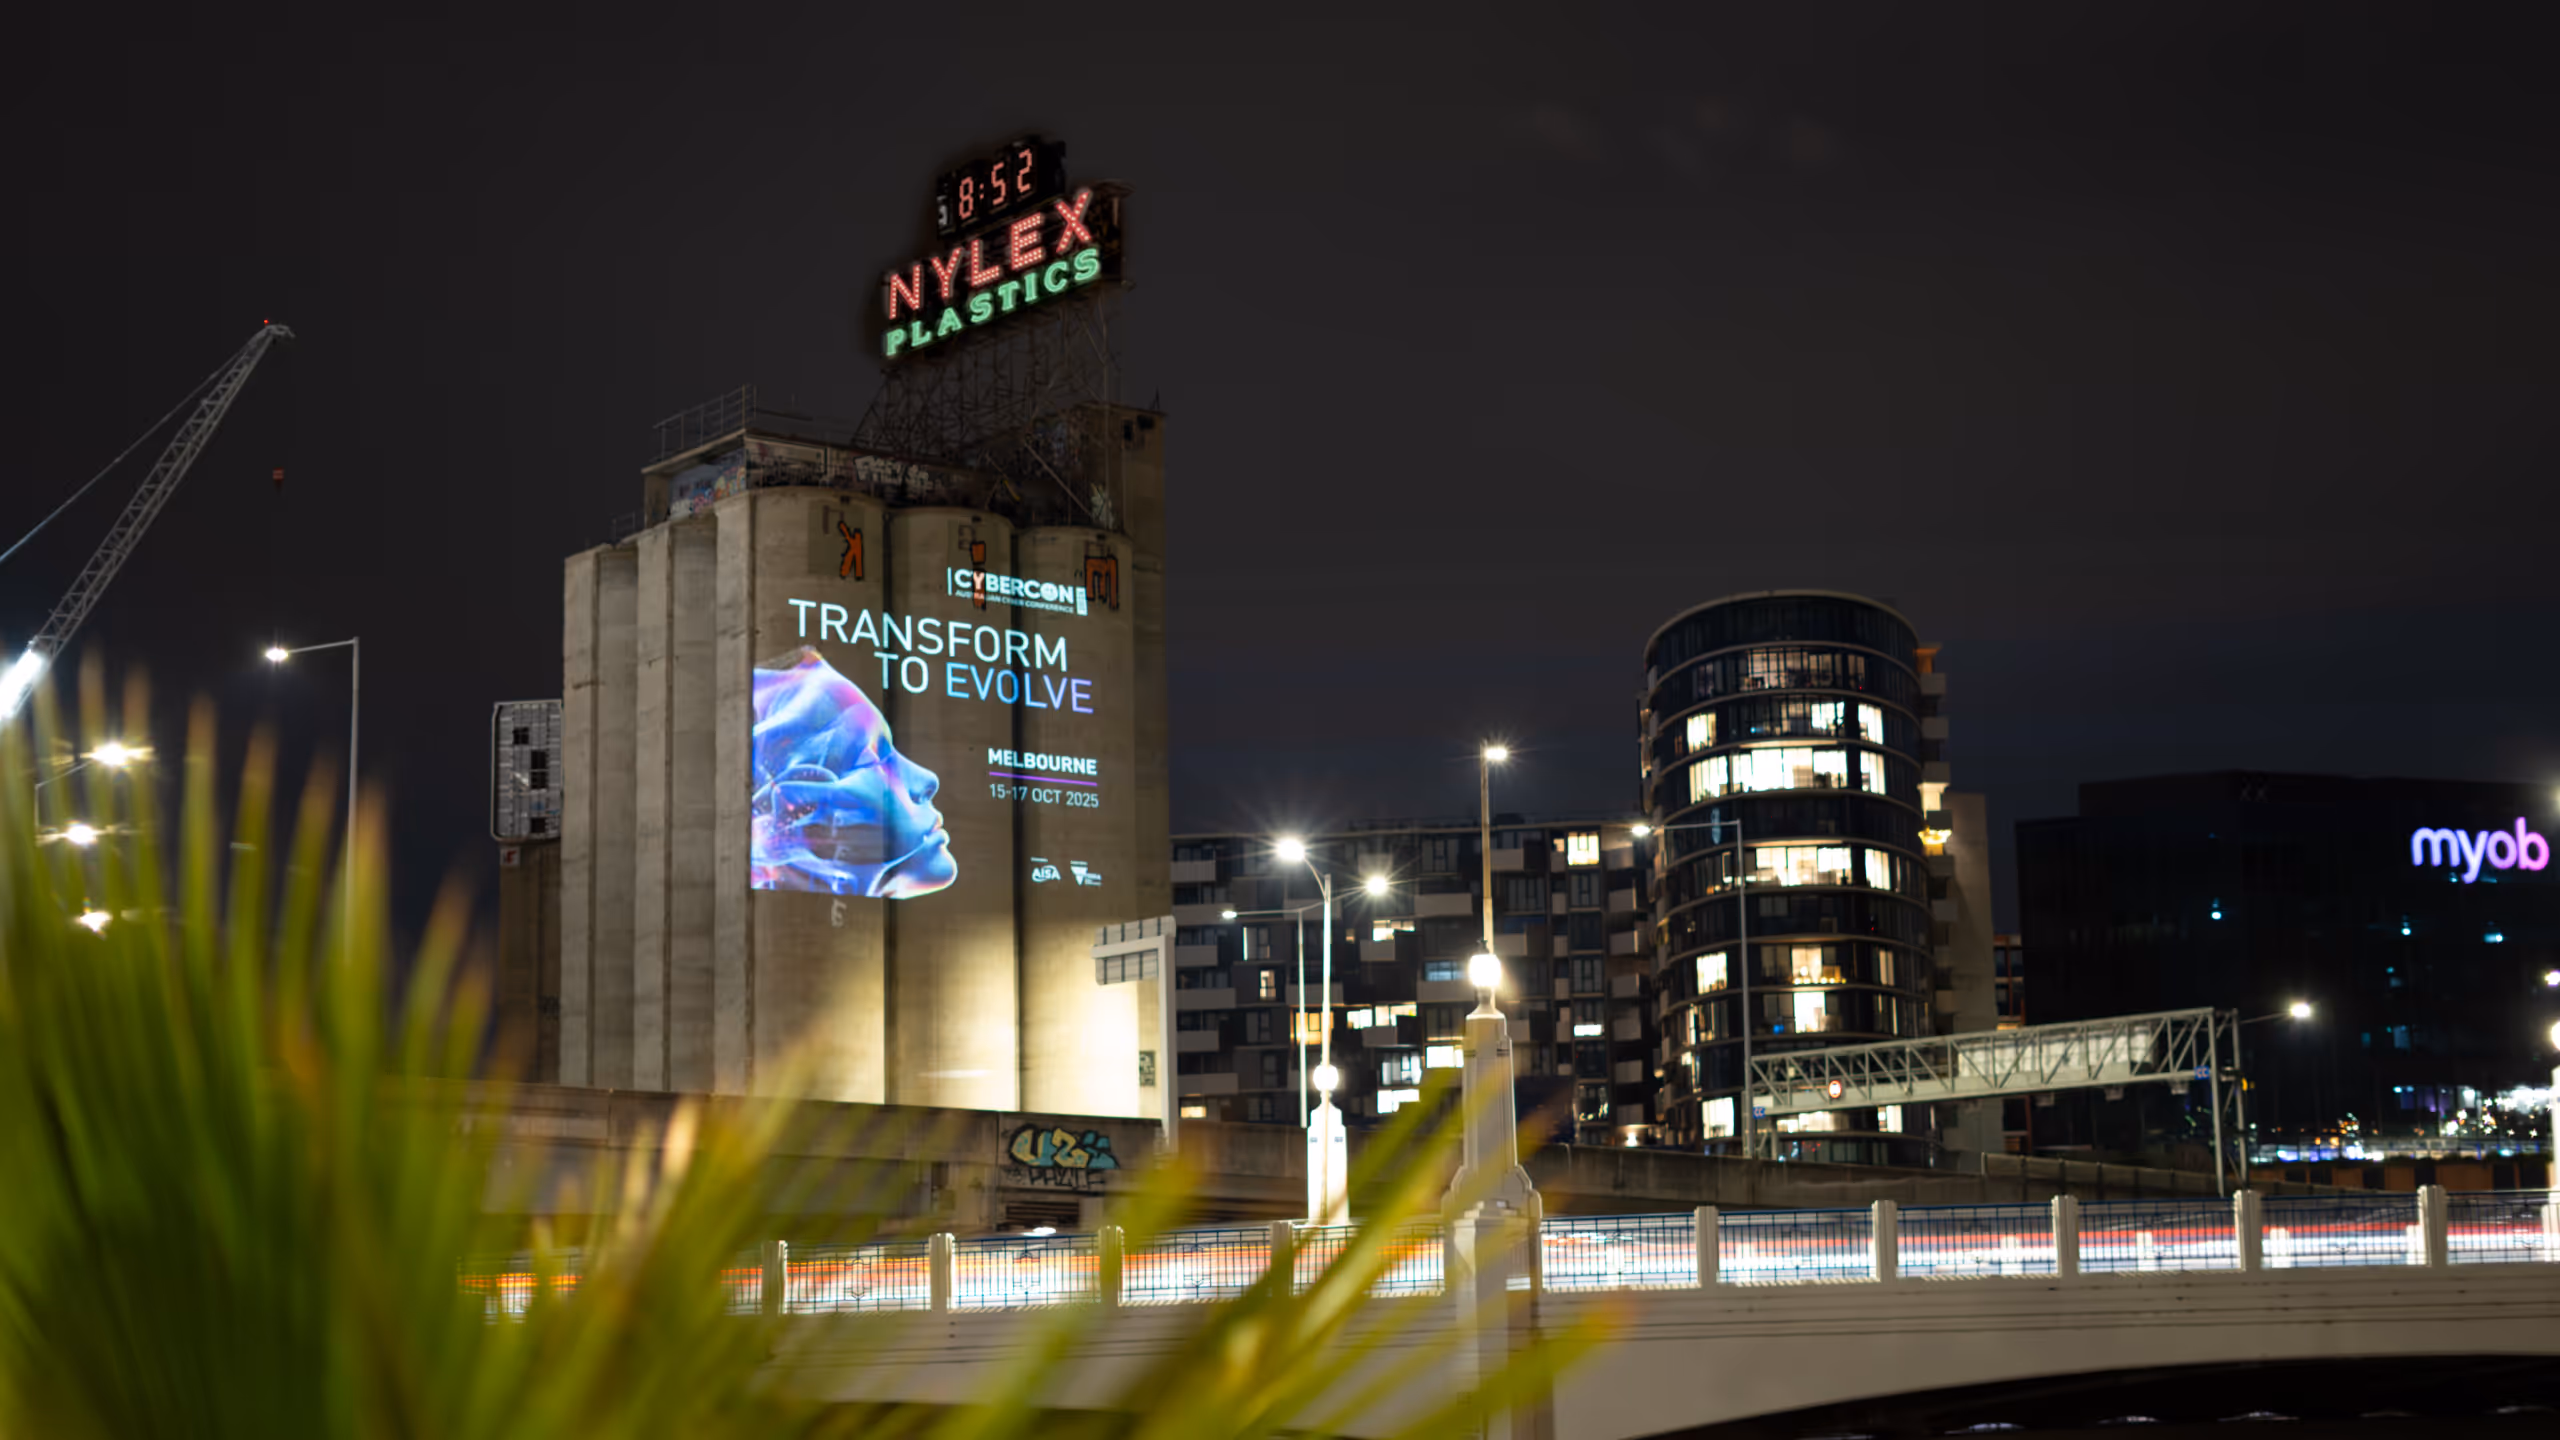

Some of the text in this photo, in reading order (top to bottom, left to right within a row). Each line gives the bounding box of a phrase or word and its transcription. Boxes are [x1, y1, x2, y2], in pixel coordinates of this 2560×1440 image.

[958, 149, 1033, 219] 8:52
[888, 188, 1094, 320] NYLEX
[885, 247, 1101, 357] PLASTICS
[954, 567, 1075, 605] CYBERCON
[788, 597, 1068, 672] TRANSFORM
[873, 651, 1094, 714] TO EVOLVE
[988, 747, 1098, 776] MELBOURNE
[989, 783, 1100, 809] 15-17 OCT 2025
[1032, 865, 1061, 883] AISA
[2410, 816, 2551, 885] myob
